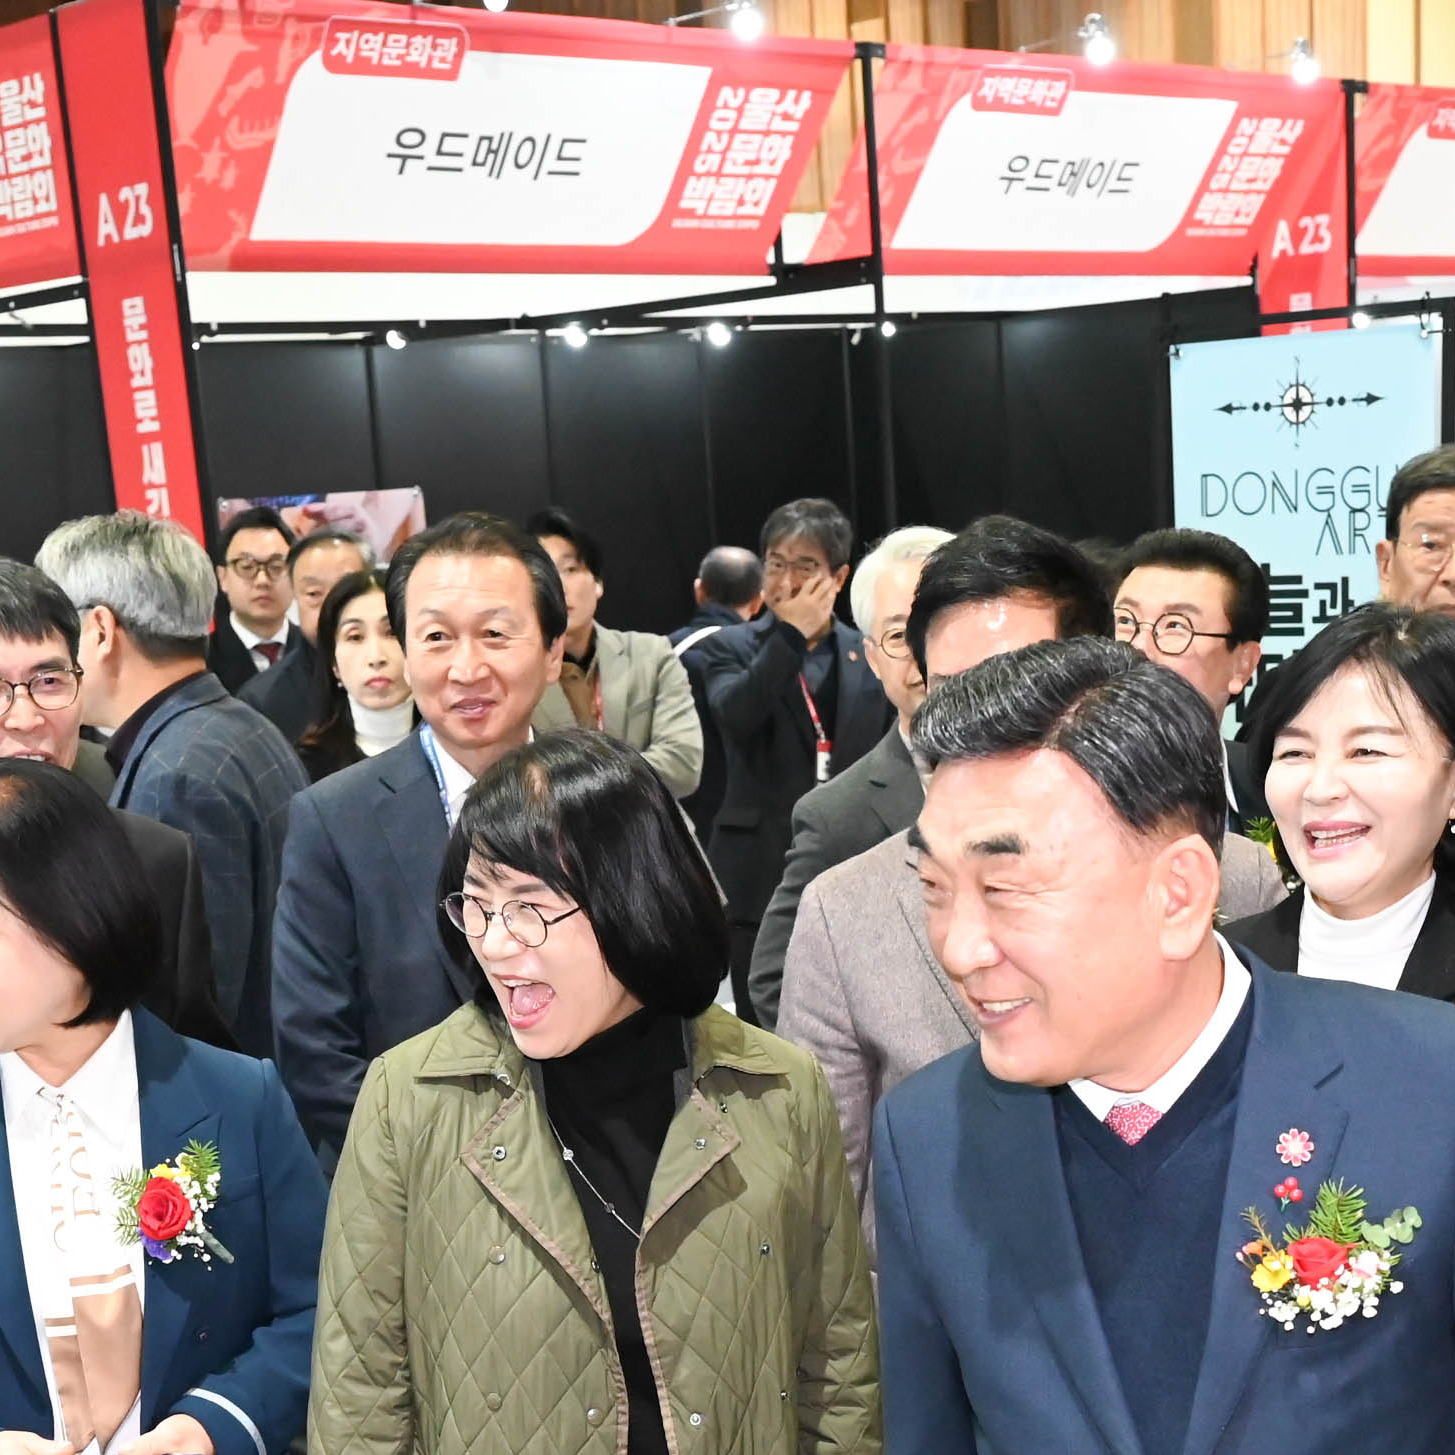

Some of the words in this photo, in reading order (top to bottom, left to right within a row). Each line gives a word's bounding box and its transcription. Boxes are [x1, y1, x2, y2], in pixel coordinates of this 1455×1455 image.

[331, 30, 459, 70] 지역문화관
[736, 86, 813, 132] 울산
[977, 75, 1068, 108] 지역문화관
[2, 121, 52, 175] 문화
[692, 85, 746, 174] 2025
[386, 127, 588, 181] 우드메이드
[720, 132, 795, 175] 문화
[678, 175, 778, 217] 박람회
[999, 155, 1141, 199] 우드메이드
[97, 192, 121, 247] A
[119, 181, 154, 241] 23
[1271, 219, 1295, 259] A
[1297, 213, 1333, 256] 23
[121, 296, 162, 434] 문화로
